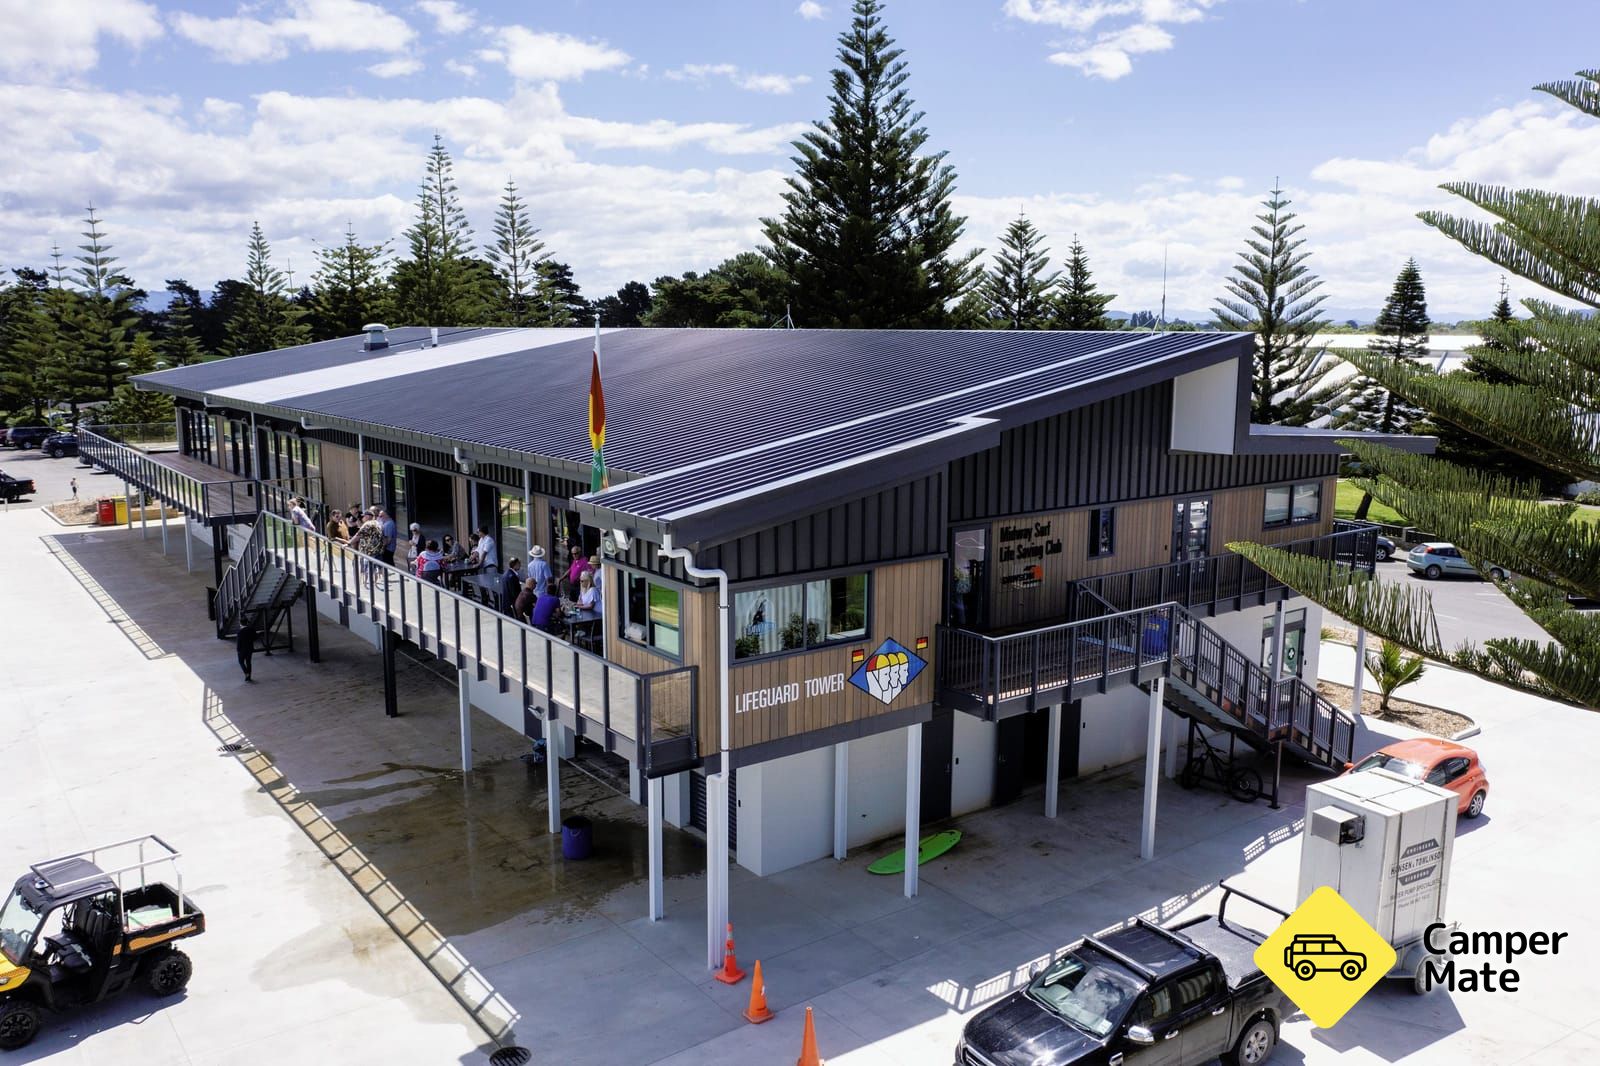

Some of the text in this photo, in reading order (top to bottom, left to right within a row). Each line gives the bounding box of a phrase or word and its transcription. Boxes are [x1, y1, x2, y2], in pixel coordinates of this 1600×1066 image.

[1000, 521, 1051, 542] Midway Surf
[1000, 539, 1062, 562] Life Saving Club
[735, 672, 845, 714] LIFEGUARD TOWER
